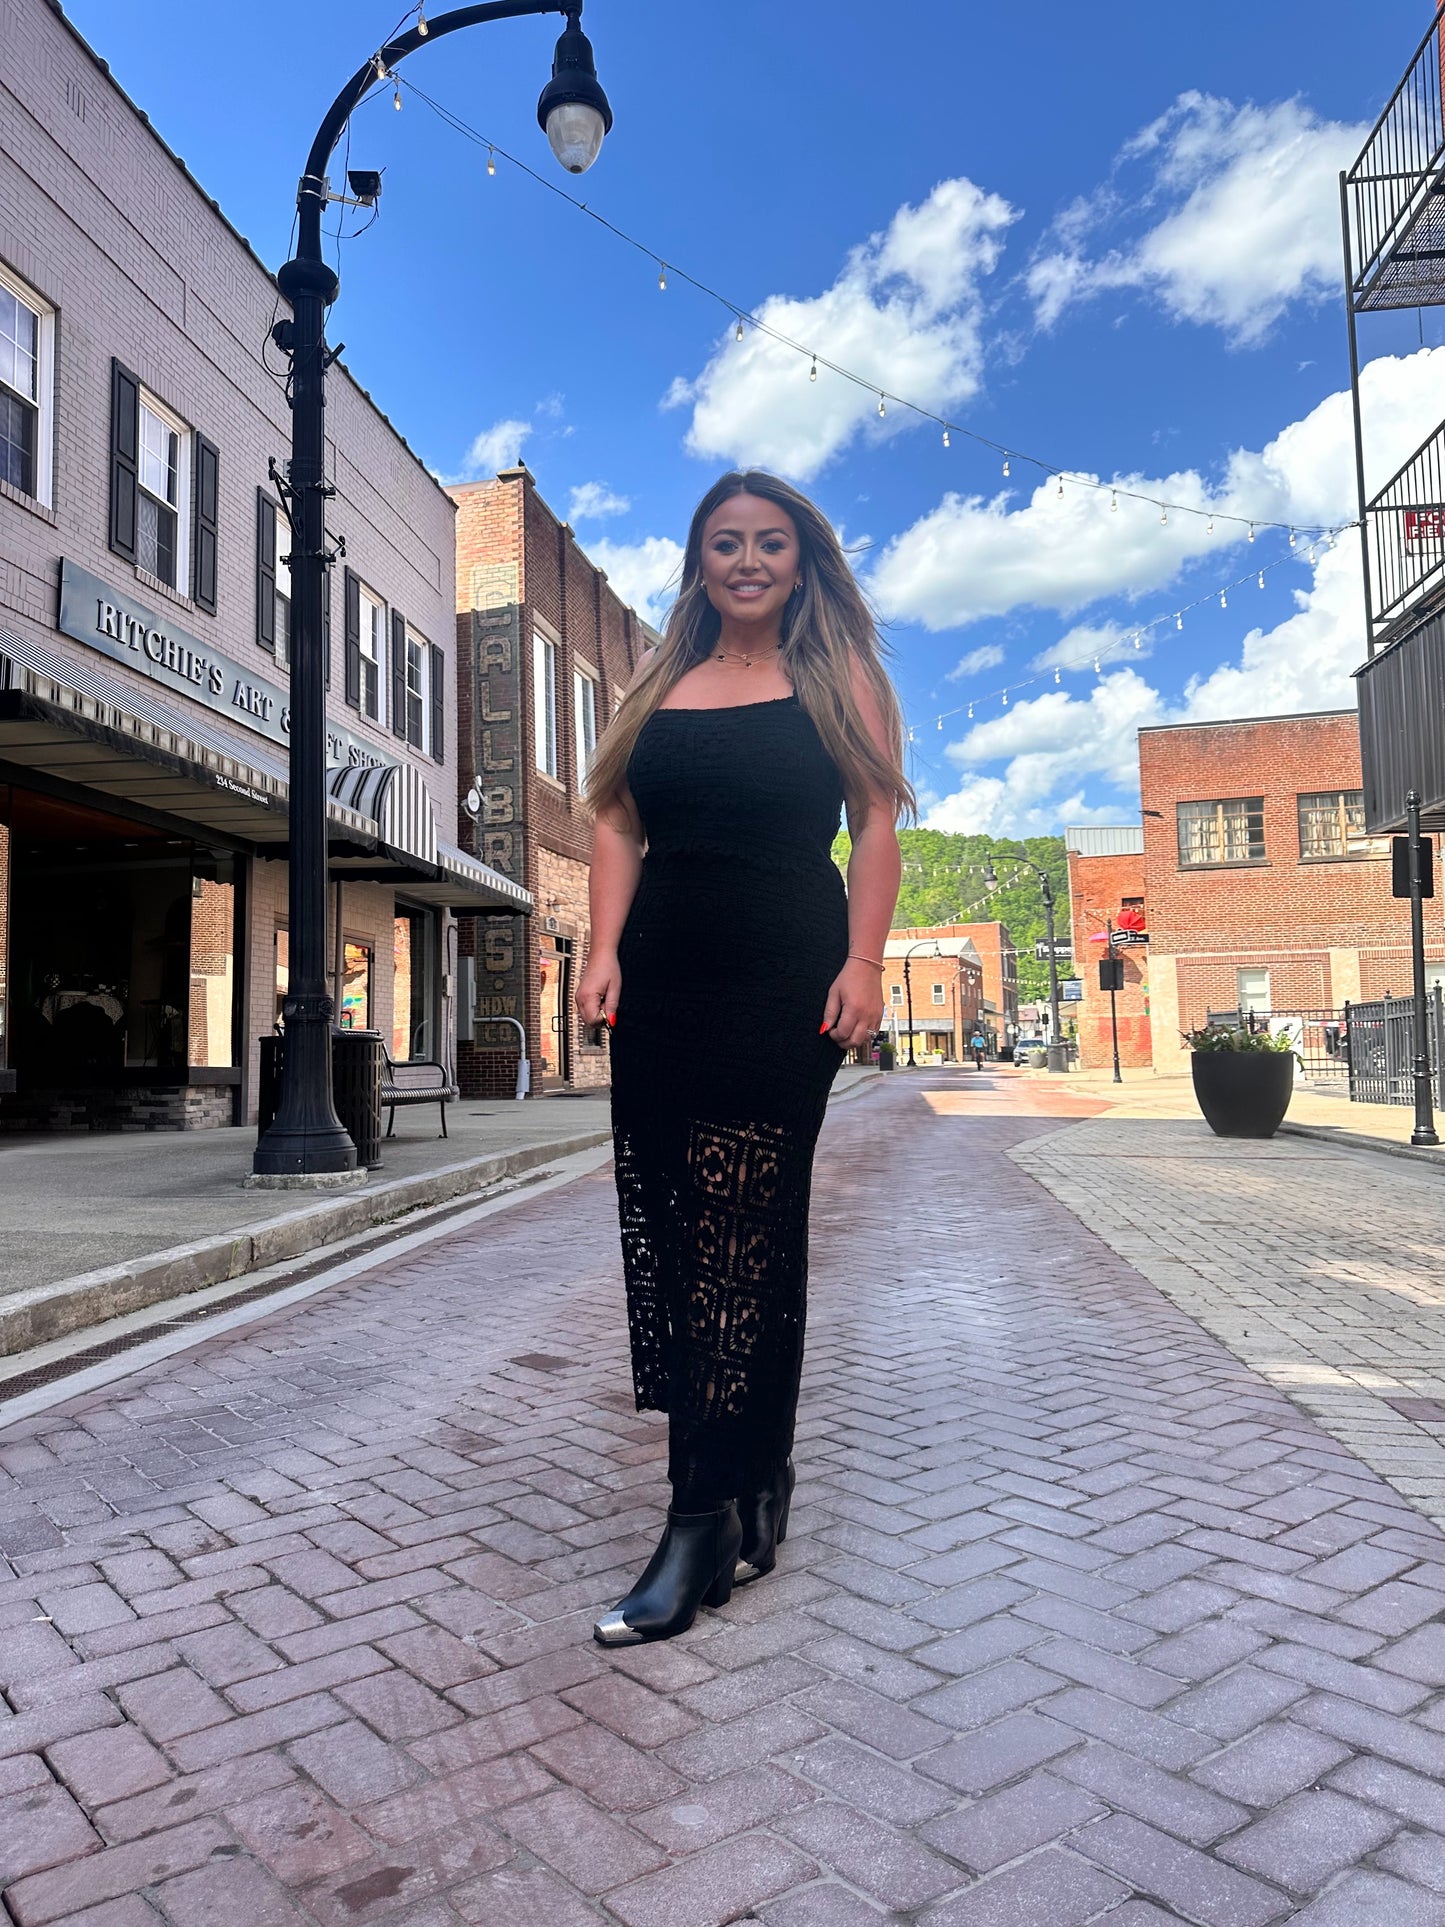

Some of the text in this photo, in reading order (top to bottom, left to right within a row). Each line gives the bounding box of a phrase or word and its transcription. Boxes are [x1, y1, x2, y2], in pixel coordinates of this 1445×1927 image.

[96, 598, 225, 696] RITCHIE'S
[231, 680, 274, 722] ART
[348, 744, 387, 768] SHO
[215, 774, 270, 805] 234 Second Street
[480, 995, 518, 1017] HDW
